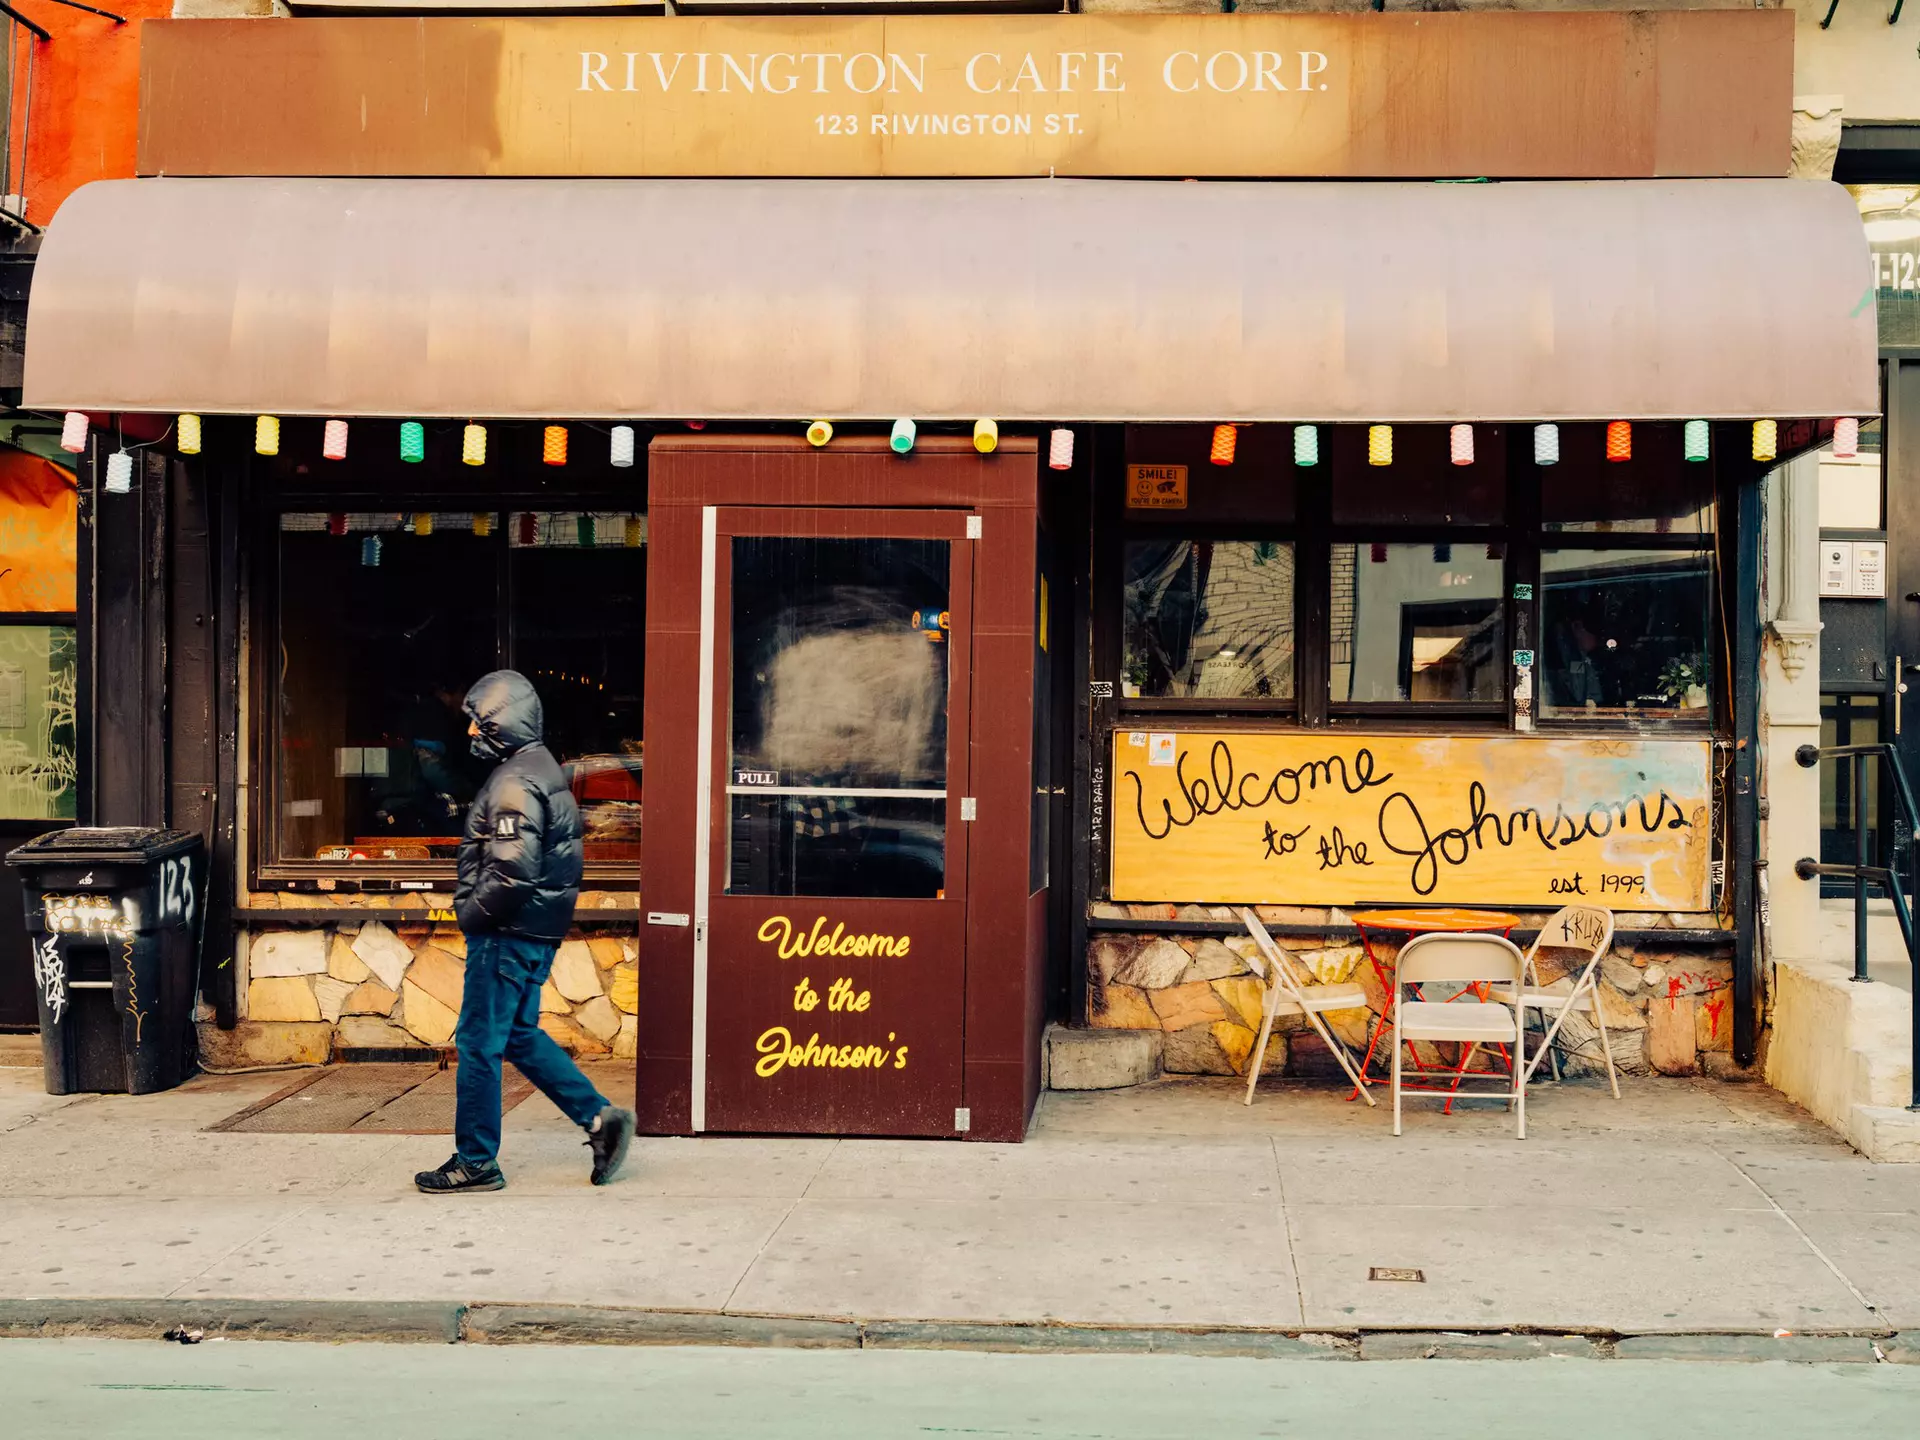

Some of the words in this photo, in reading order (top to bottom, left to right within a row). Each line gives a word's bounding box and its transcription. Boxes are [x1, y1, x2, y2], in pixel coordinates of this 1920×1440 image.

[576, 51, 926, 94] RIVINGTON
[965, 52, 1126, 94] CAFE
[1162, 50, 1329, 93] CORP.
[815, 114, 859, 135] 123
[870, 114, 1032, 135] RIVINGTON
[1043, 113, 1084, 135] ST.
[1872, 252, 1920, 290] 1-12
[1138, 469, 1177, 479] SMILE!
[738, 772, 774, 784] PULL
[1124, 740, 1394, 840] Welcome
[1262, 820, 1311, 860] to
[1316, 826, 1374, 871] the
[158, 855, 195, 922] 123
[1548, 871, 1589, 894] est.
[1599, 873, 1646, 894] 1999
[757, 915, 911, 960] Welcome
[793, 976, 821, 1012] to
[828, 977, 872, 1012] the
[755, 1026, 909, 1078] Johnson's
